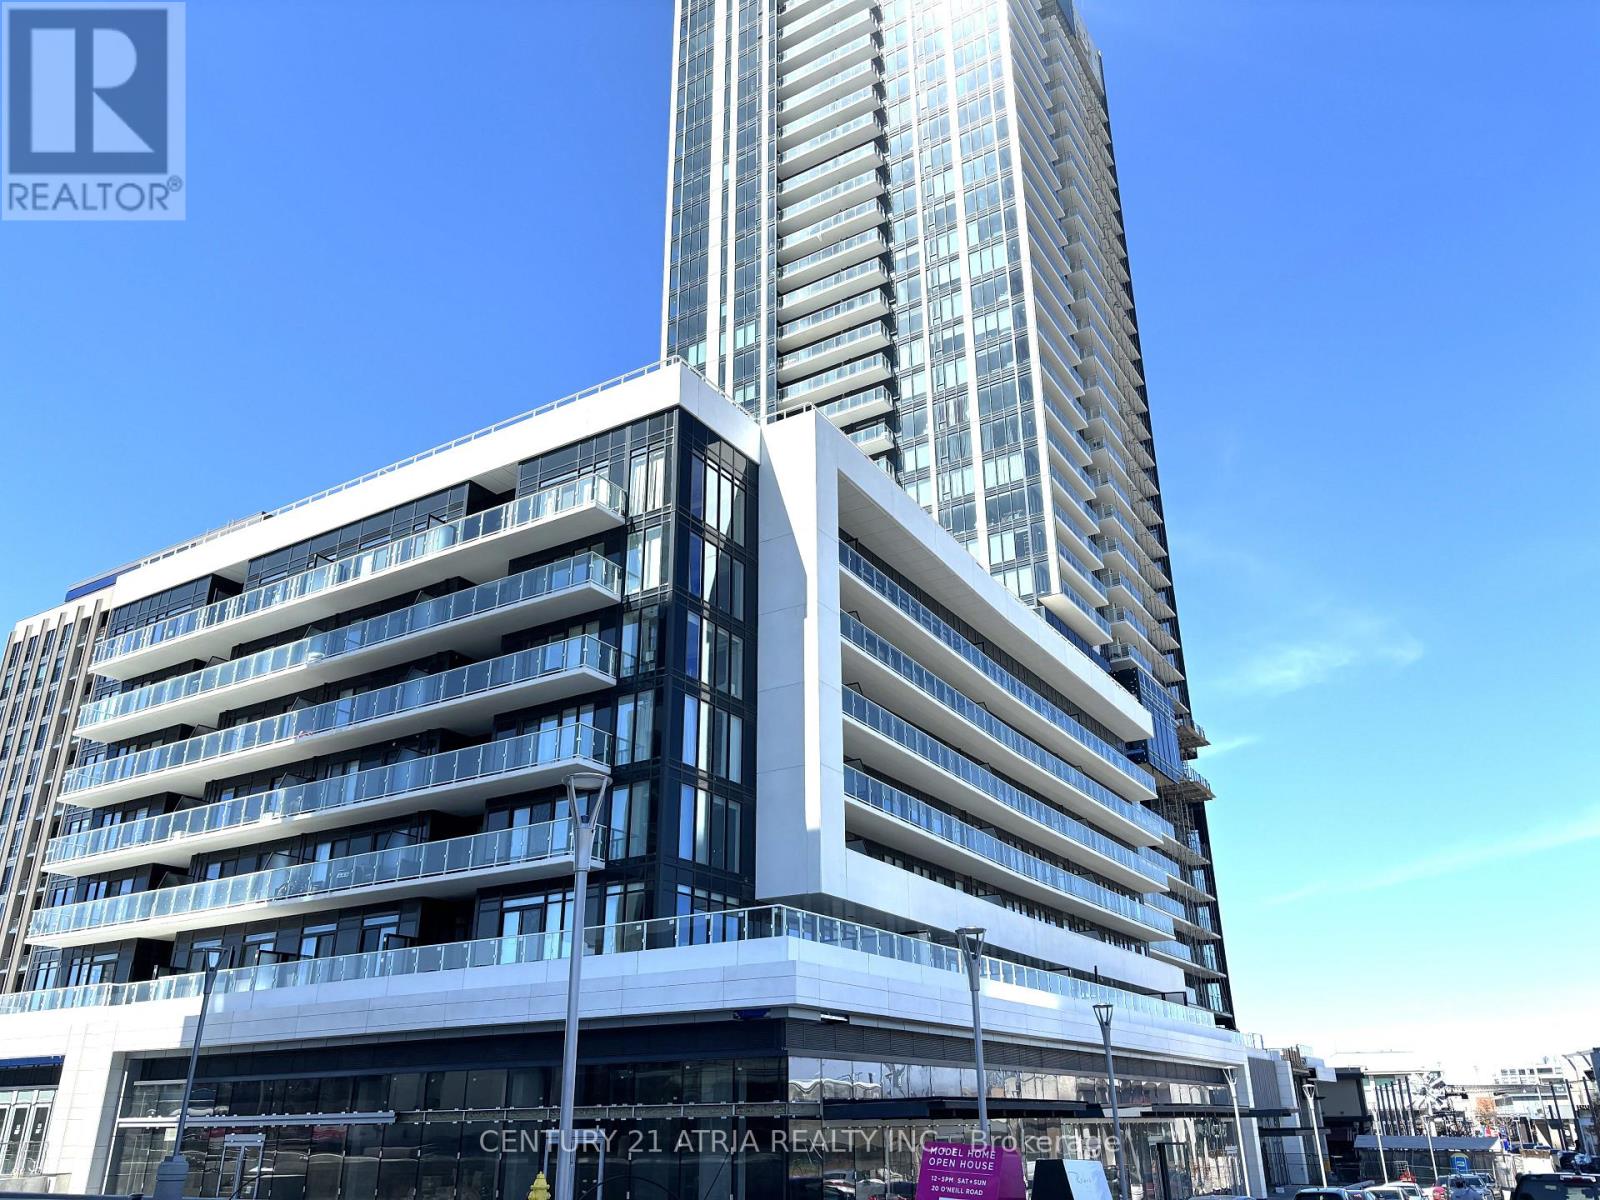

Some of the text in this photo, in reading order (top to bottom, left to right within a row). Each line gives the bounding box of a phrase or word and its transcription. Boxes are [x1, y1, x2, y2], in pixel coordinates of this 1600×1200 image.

[930, 1146, 996, 1160] MODEL HOME
[928, 1157, 995, 1171] OPEN HOUSE
[965, 1188, 984, 1196] ROAD
